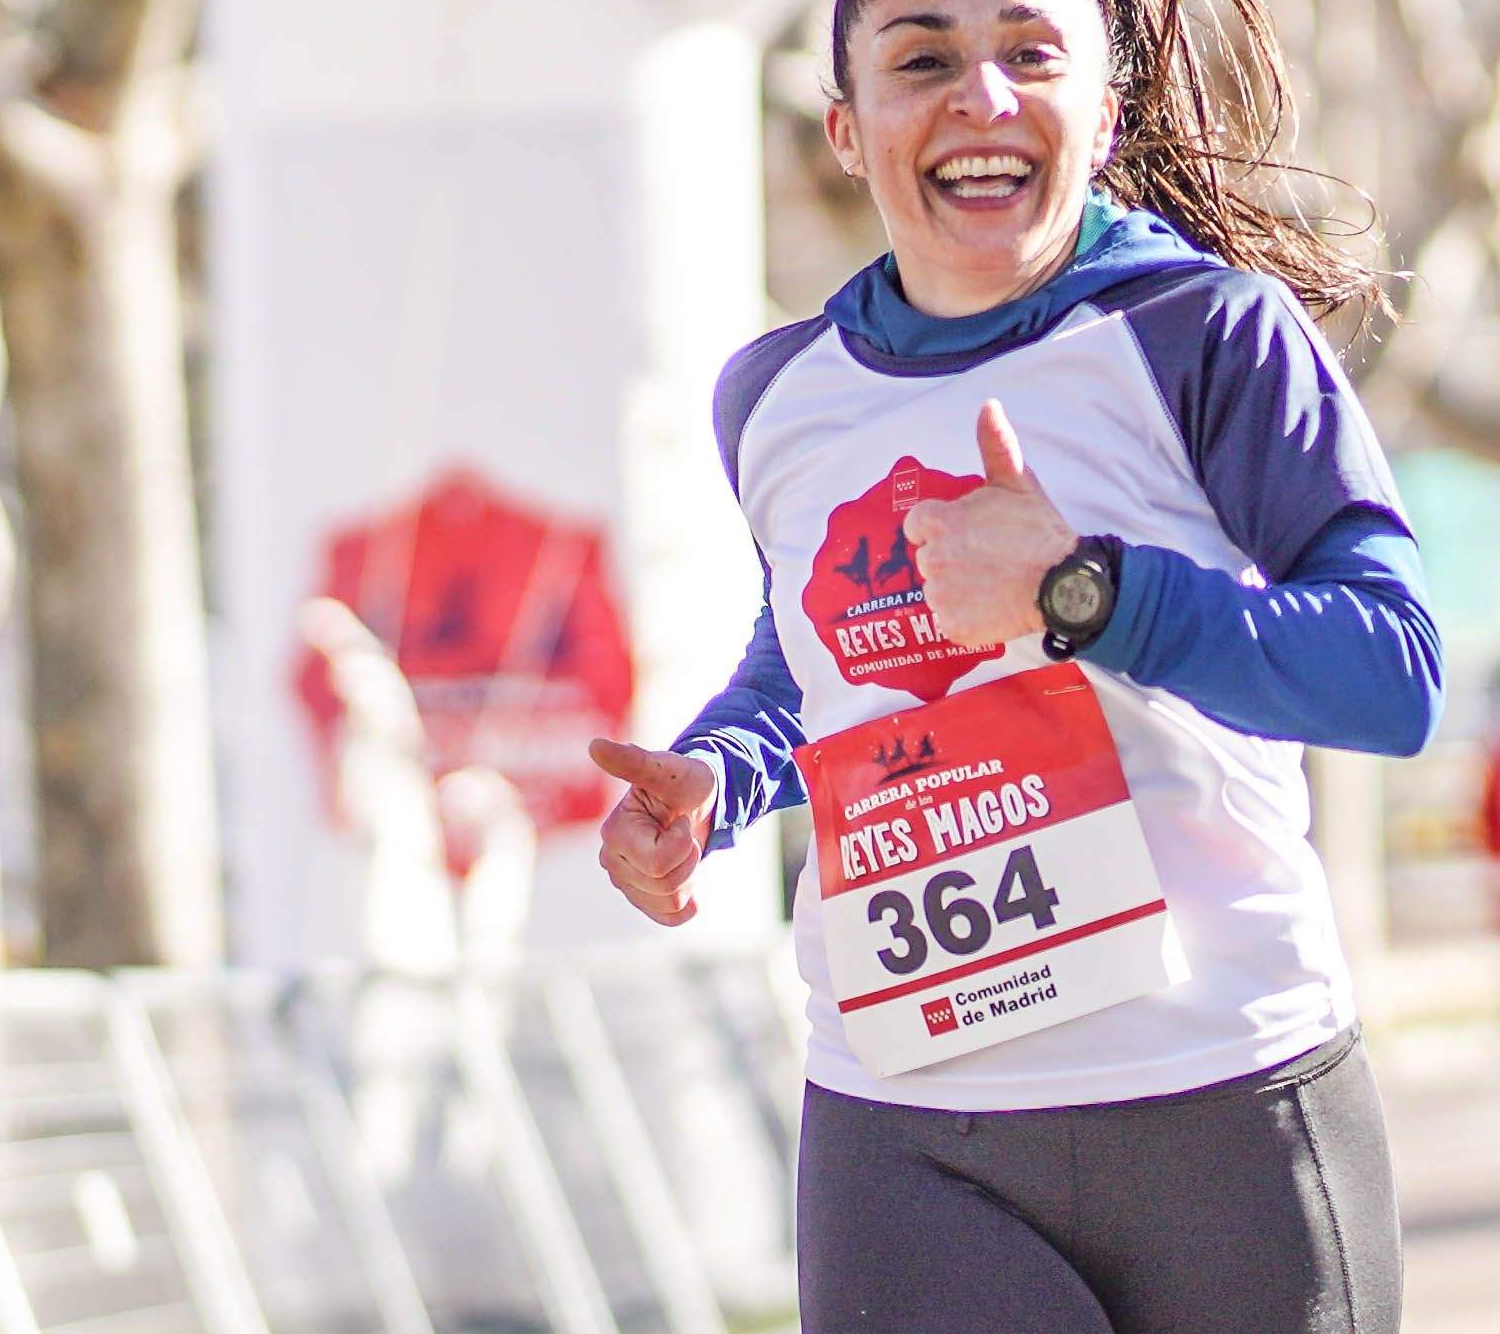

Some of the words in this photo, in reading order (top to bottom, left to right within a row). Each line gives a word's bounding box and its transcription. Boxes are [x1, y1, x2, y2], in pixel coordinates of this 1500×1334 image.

[847, 594, 903, 618] CARRERA
[836, 619, 906, 658] REYES
[849, 653, 923, 677] COMUNIDAD
[927, 650, 946, 661] DE
[844, 783, 913, 821] CARRERA
[915, 759, 1004, 793] POPULAR
[839, 818, 918, 881] REYES
[923, 774, 1050, 855] MAGOS
[868, 844, 1060, 976] 364
[955, 964, 1052, 1007] Comunidad
[962, 1010, 985, 1028] de
[989, 983, 1058, 1019] Madrid
